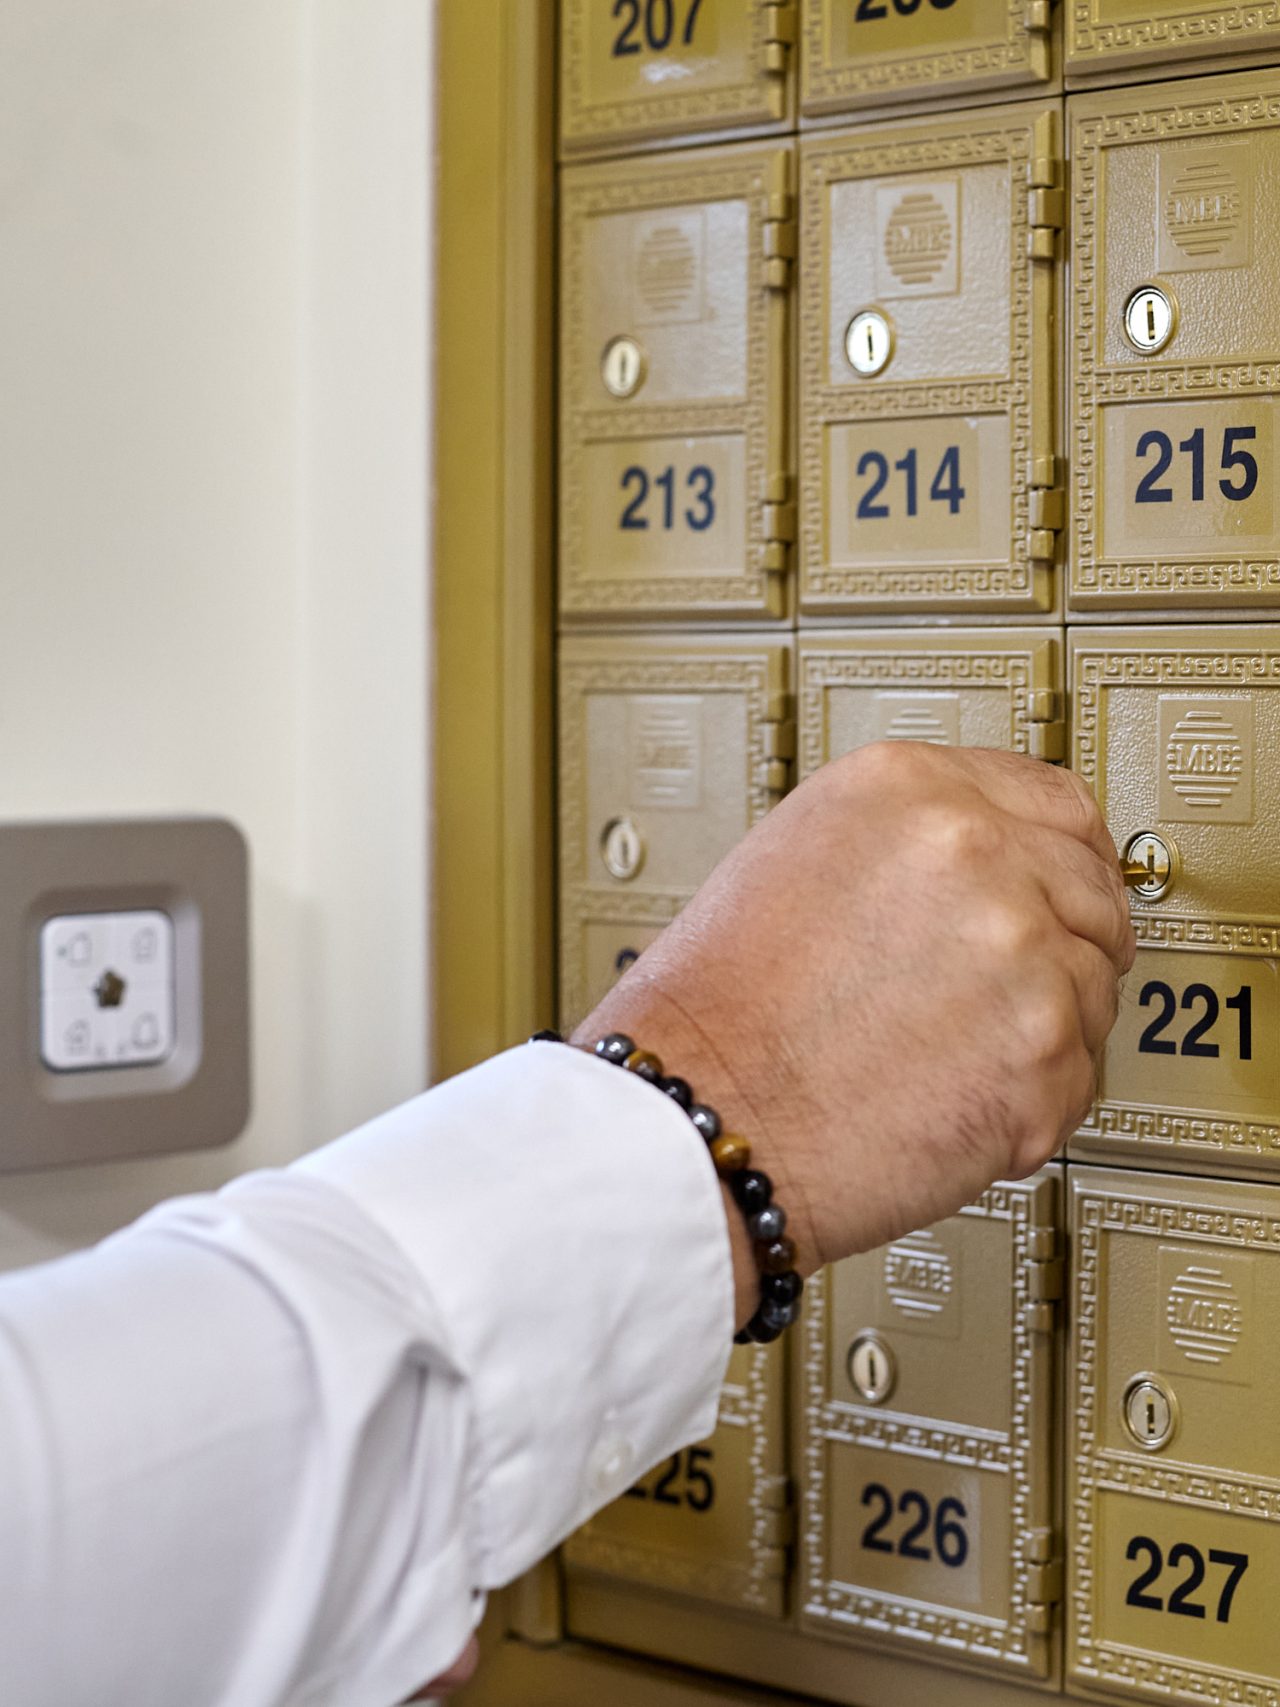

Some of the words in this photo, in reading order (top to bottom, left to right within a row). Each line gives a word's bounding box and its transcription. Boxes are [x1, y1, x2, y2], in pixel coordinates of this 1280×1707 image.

[611, 0, 702, 57] 207
[1175, 195, 1230, 222] MBE
[856, 446, 965, 519] 214
[1135, 426, 1258, 503] 215
[618, 465, 716, 531] 213
[1174, 745, 1231, 773] MBE
[1139, 981, 1251, 1060] 221
[1176, 1301, 1231, 1330] MBE
[622, 1446, 714, 1512] 25
[861, 1483, 968, 1567] 226
[1126, 1536, 1248, 1623] 227
